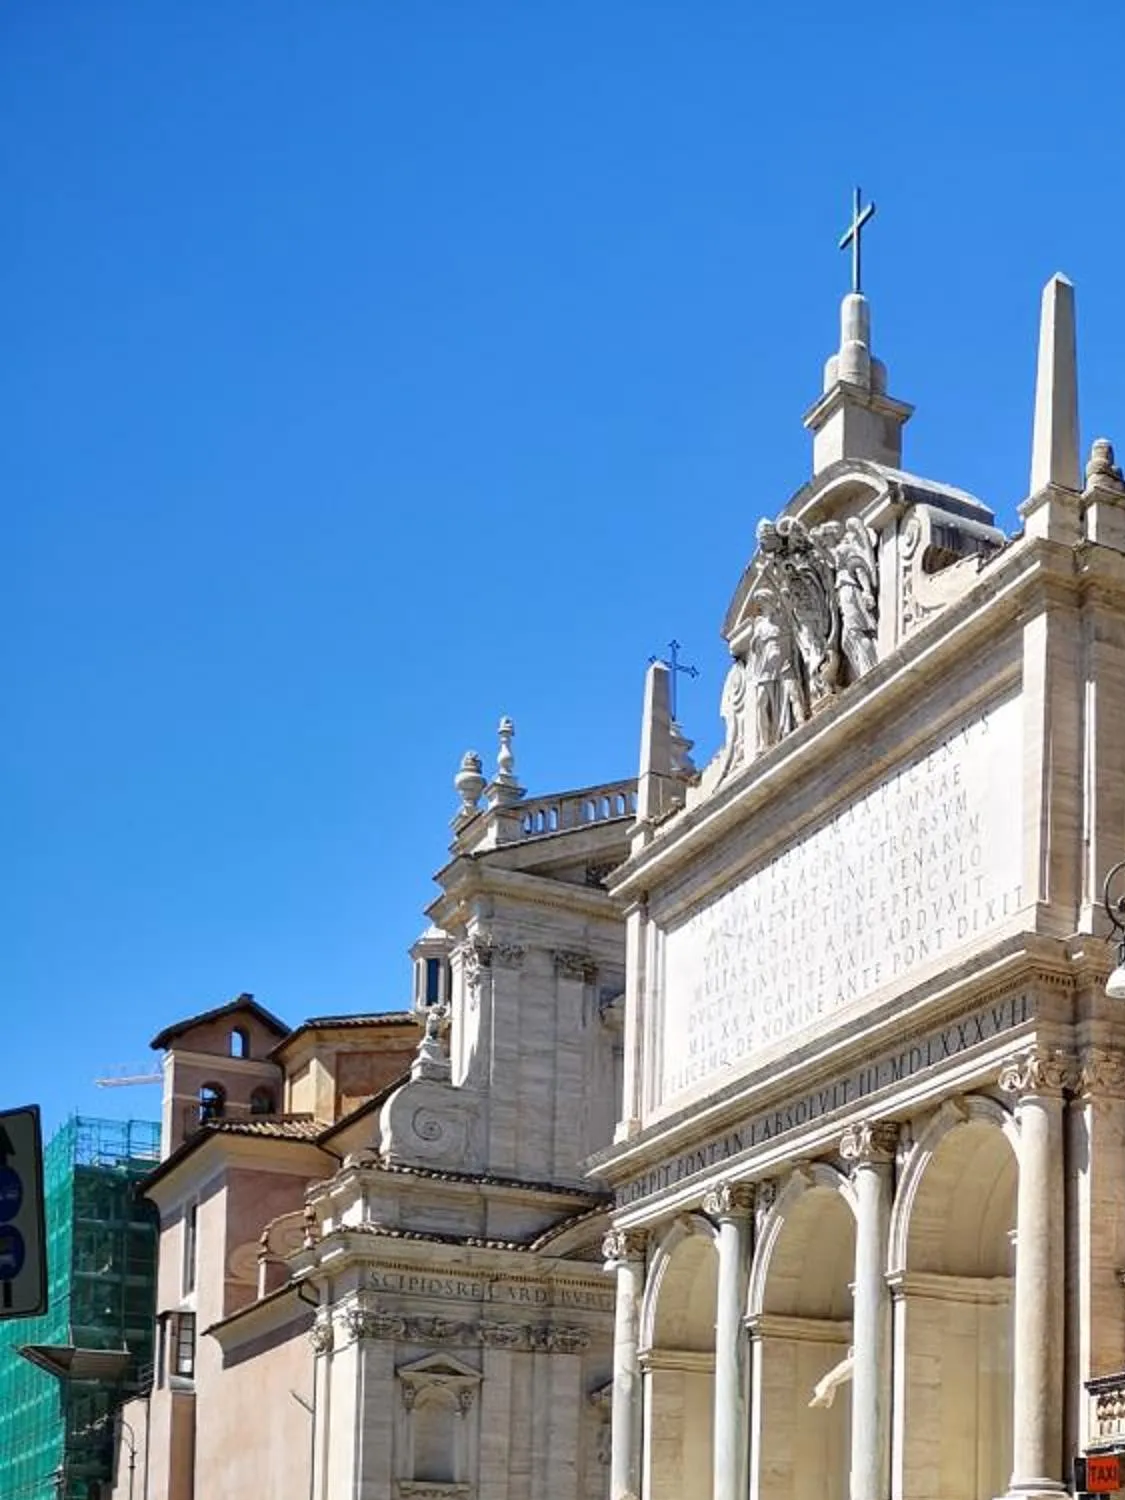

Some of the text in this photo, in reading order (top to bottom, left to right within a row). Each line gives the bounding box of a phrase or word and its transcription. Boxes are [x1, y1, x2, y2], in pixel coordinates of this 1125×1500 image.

[834, 958, 882, 1007] ANTE
[891, 923, 945, 975] PONT
[956, 881, 1023, 941] DIXIT
[1089, 1465, 1119, 1482] TAXI
